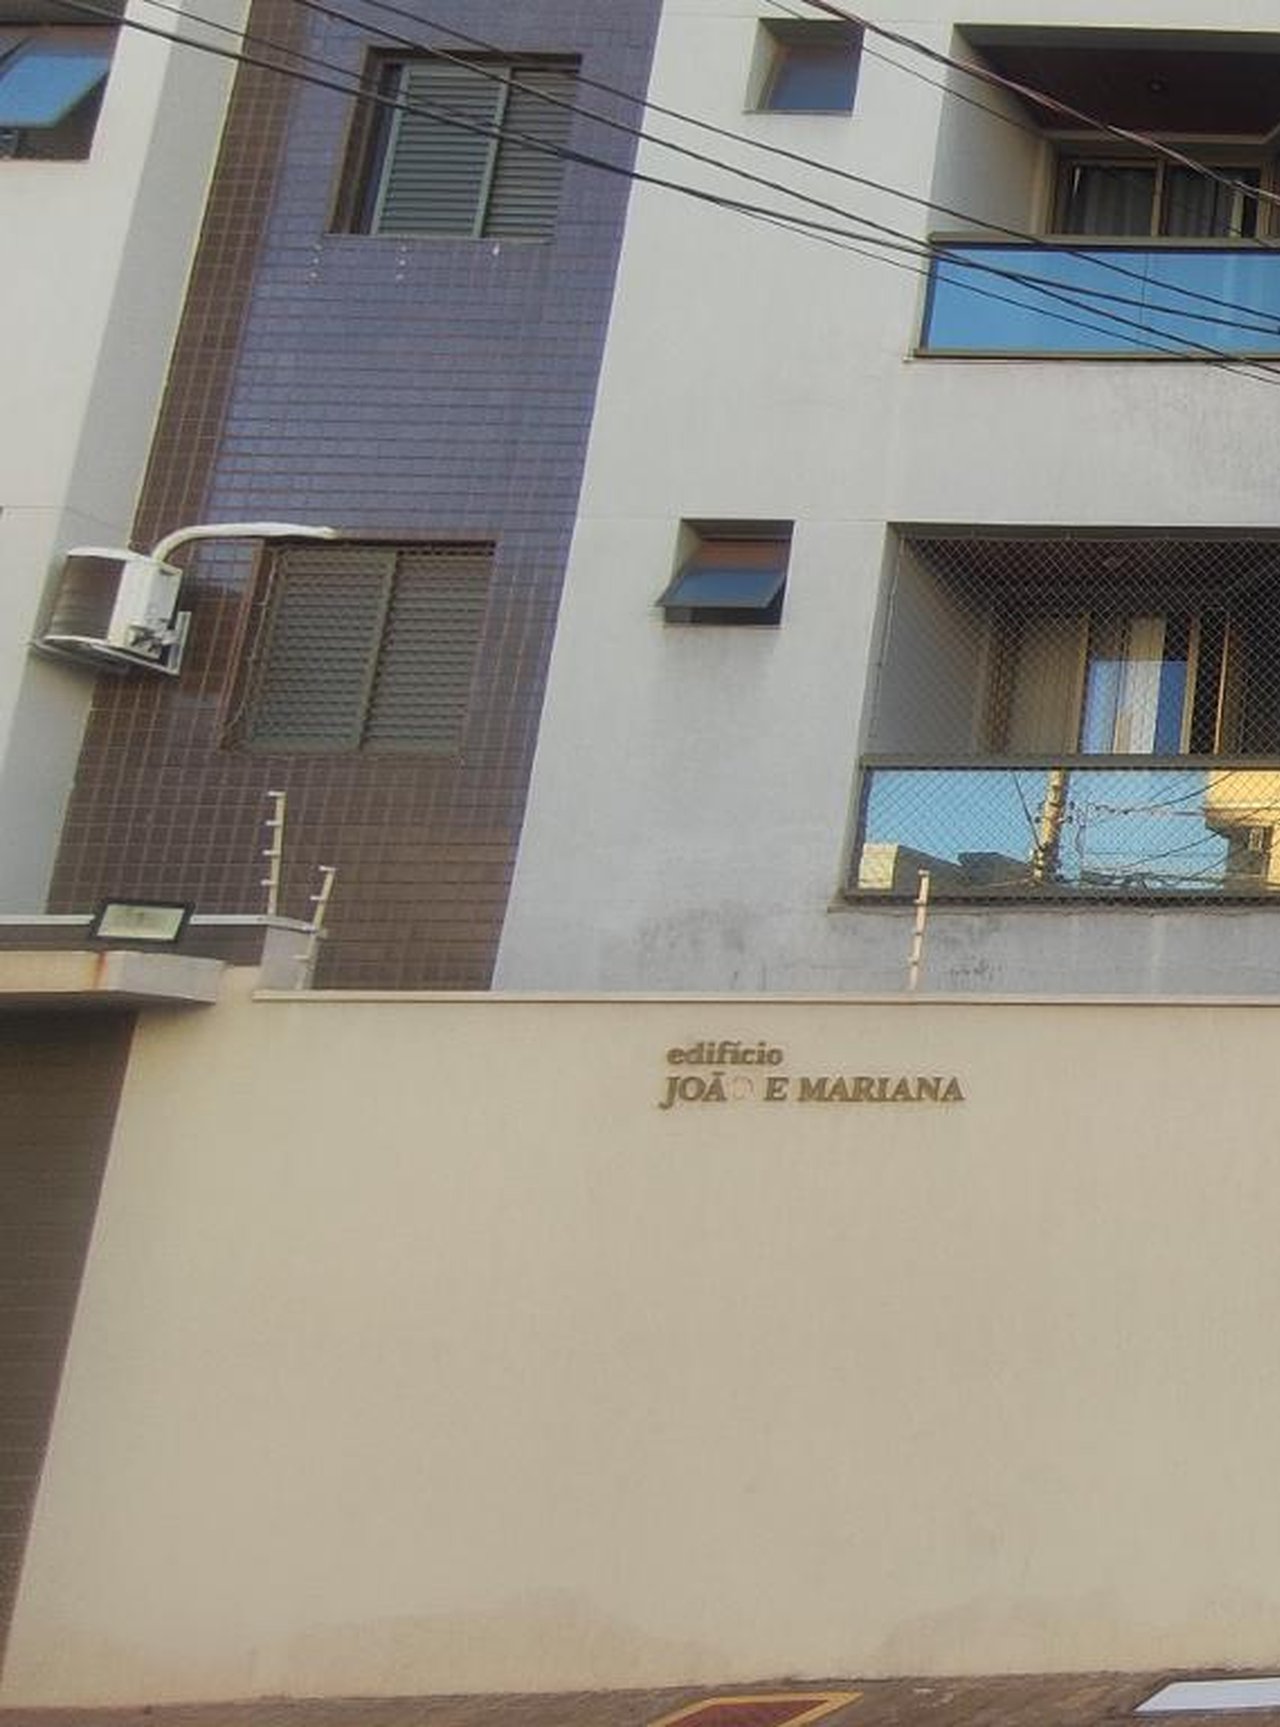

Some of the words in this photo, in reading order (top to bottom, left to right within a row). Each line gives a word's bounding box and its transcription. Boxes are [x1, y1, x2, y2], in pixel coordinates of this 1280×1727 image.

[666, 1040, 783, 1066] edifício
[764, 1076, 790, 1101] E
[797, 1076, 966, 1102] MARIANA
